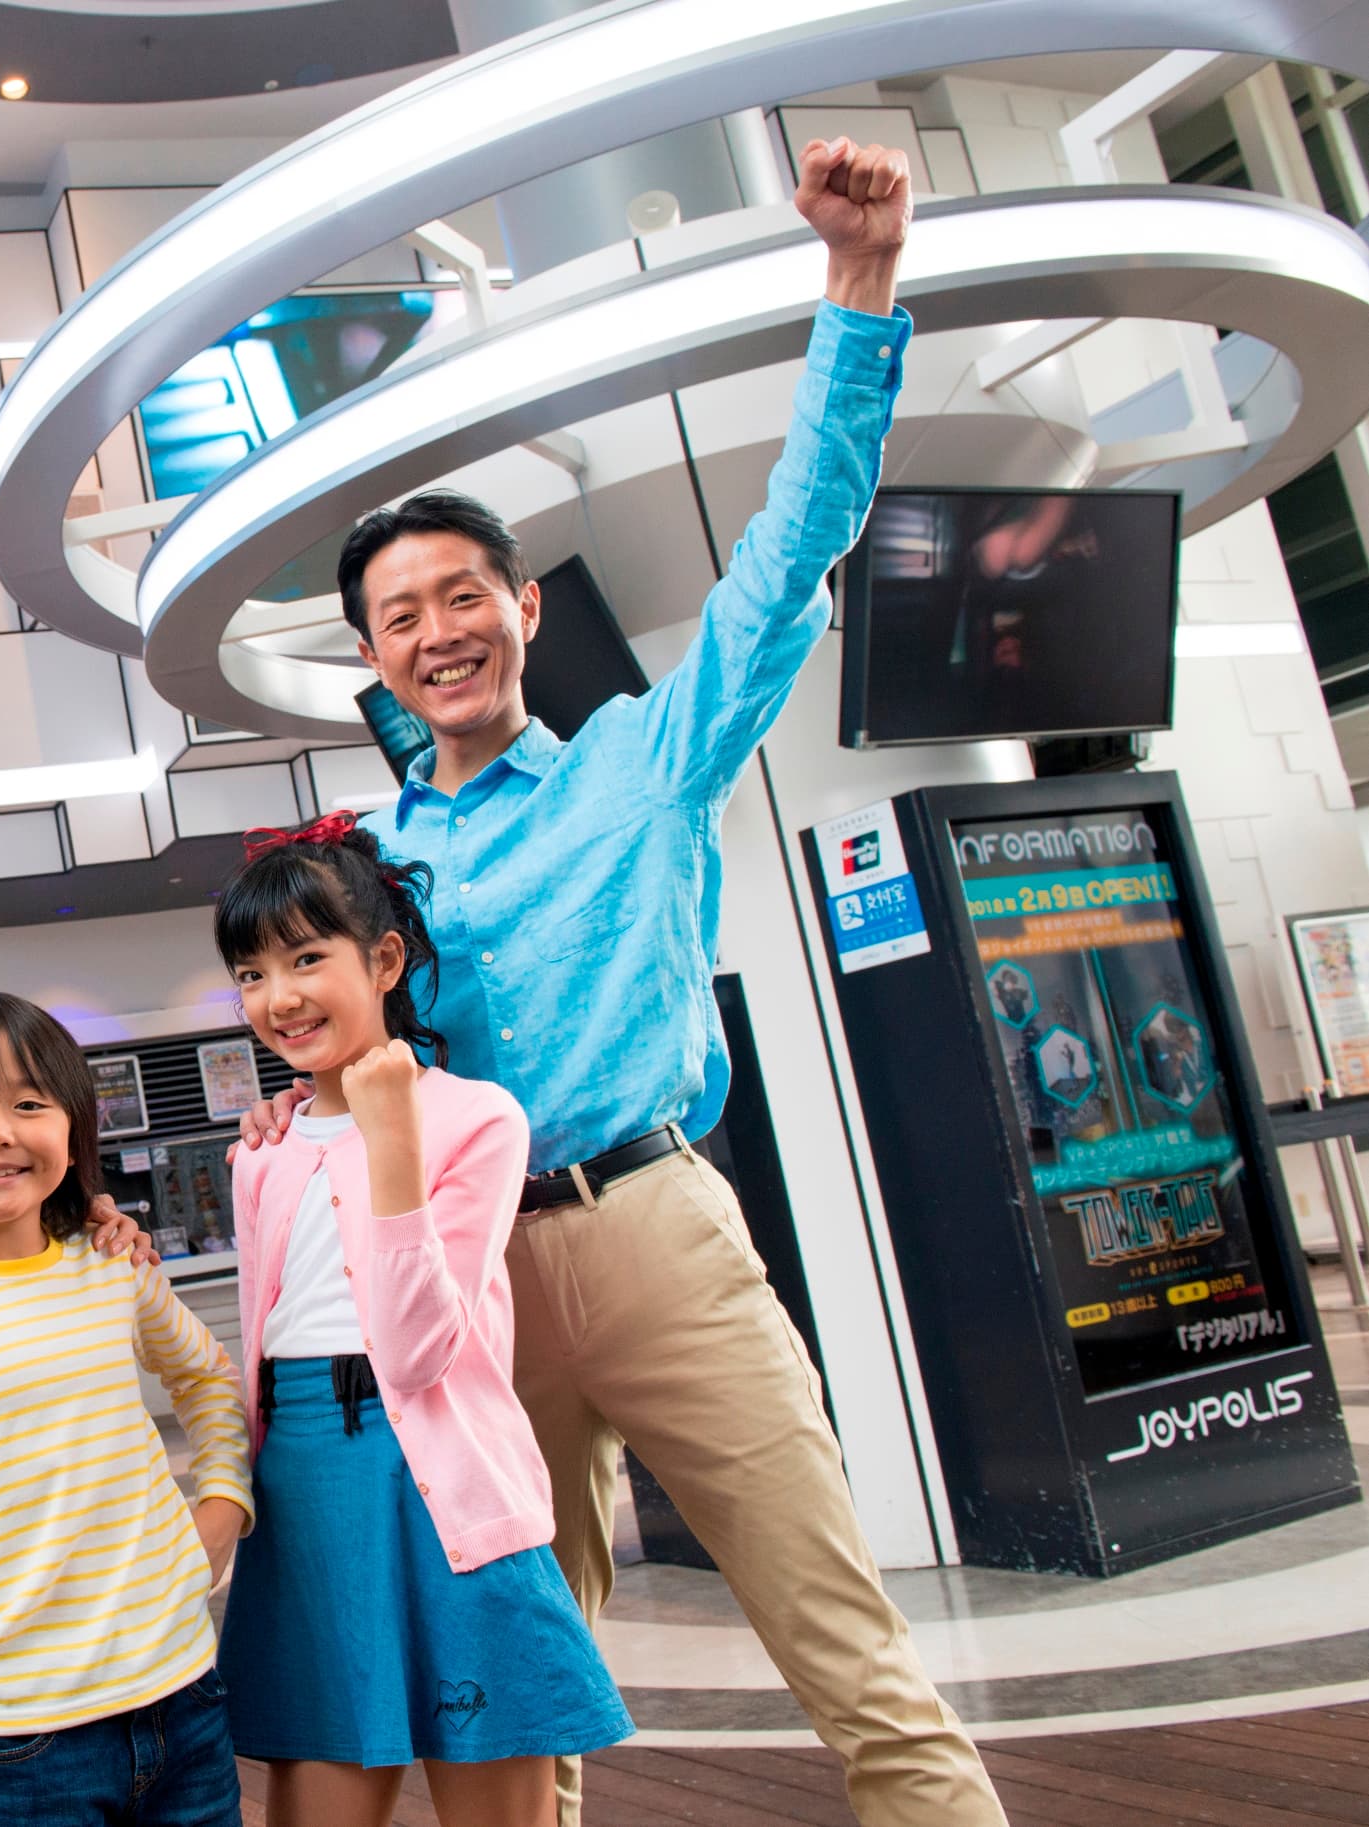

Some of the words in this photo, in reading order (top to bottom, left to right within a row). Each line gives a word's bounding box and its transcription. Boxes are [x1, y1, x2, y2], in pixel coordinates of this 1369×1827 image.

[952, 822, 1158, 866] INFORMATION
[153, 1148, 168, 1165] 2
[1106, 1370, 1314, 1463] JOYPOLIS
